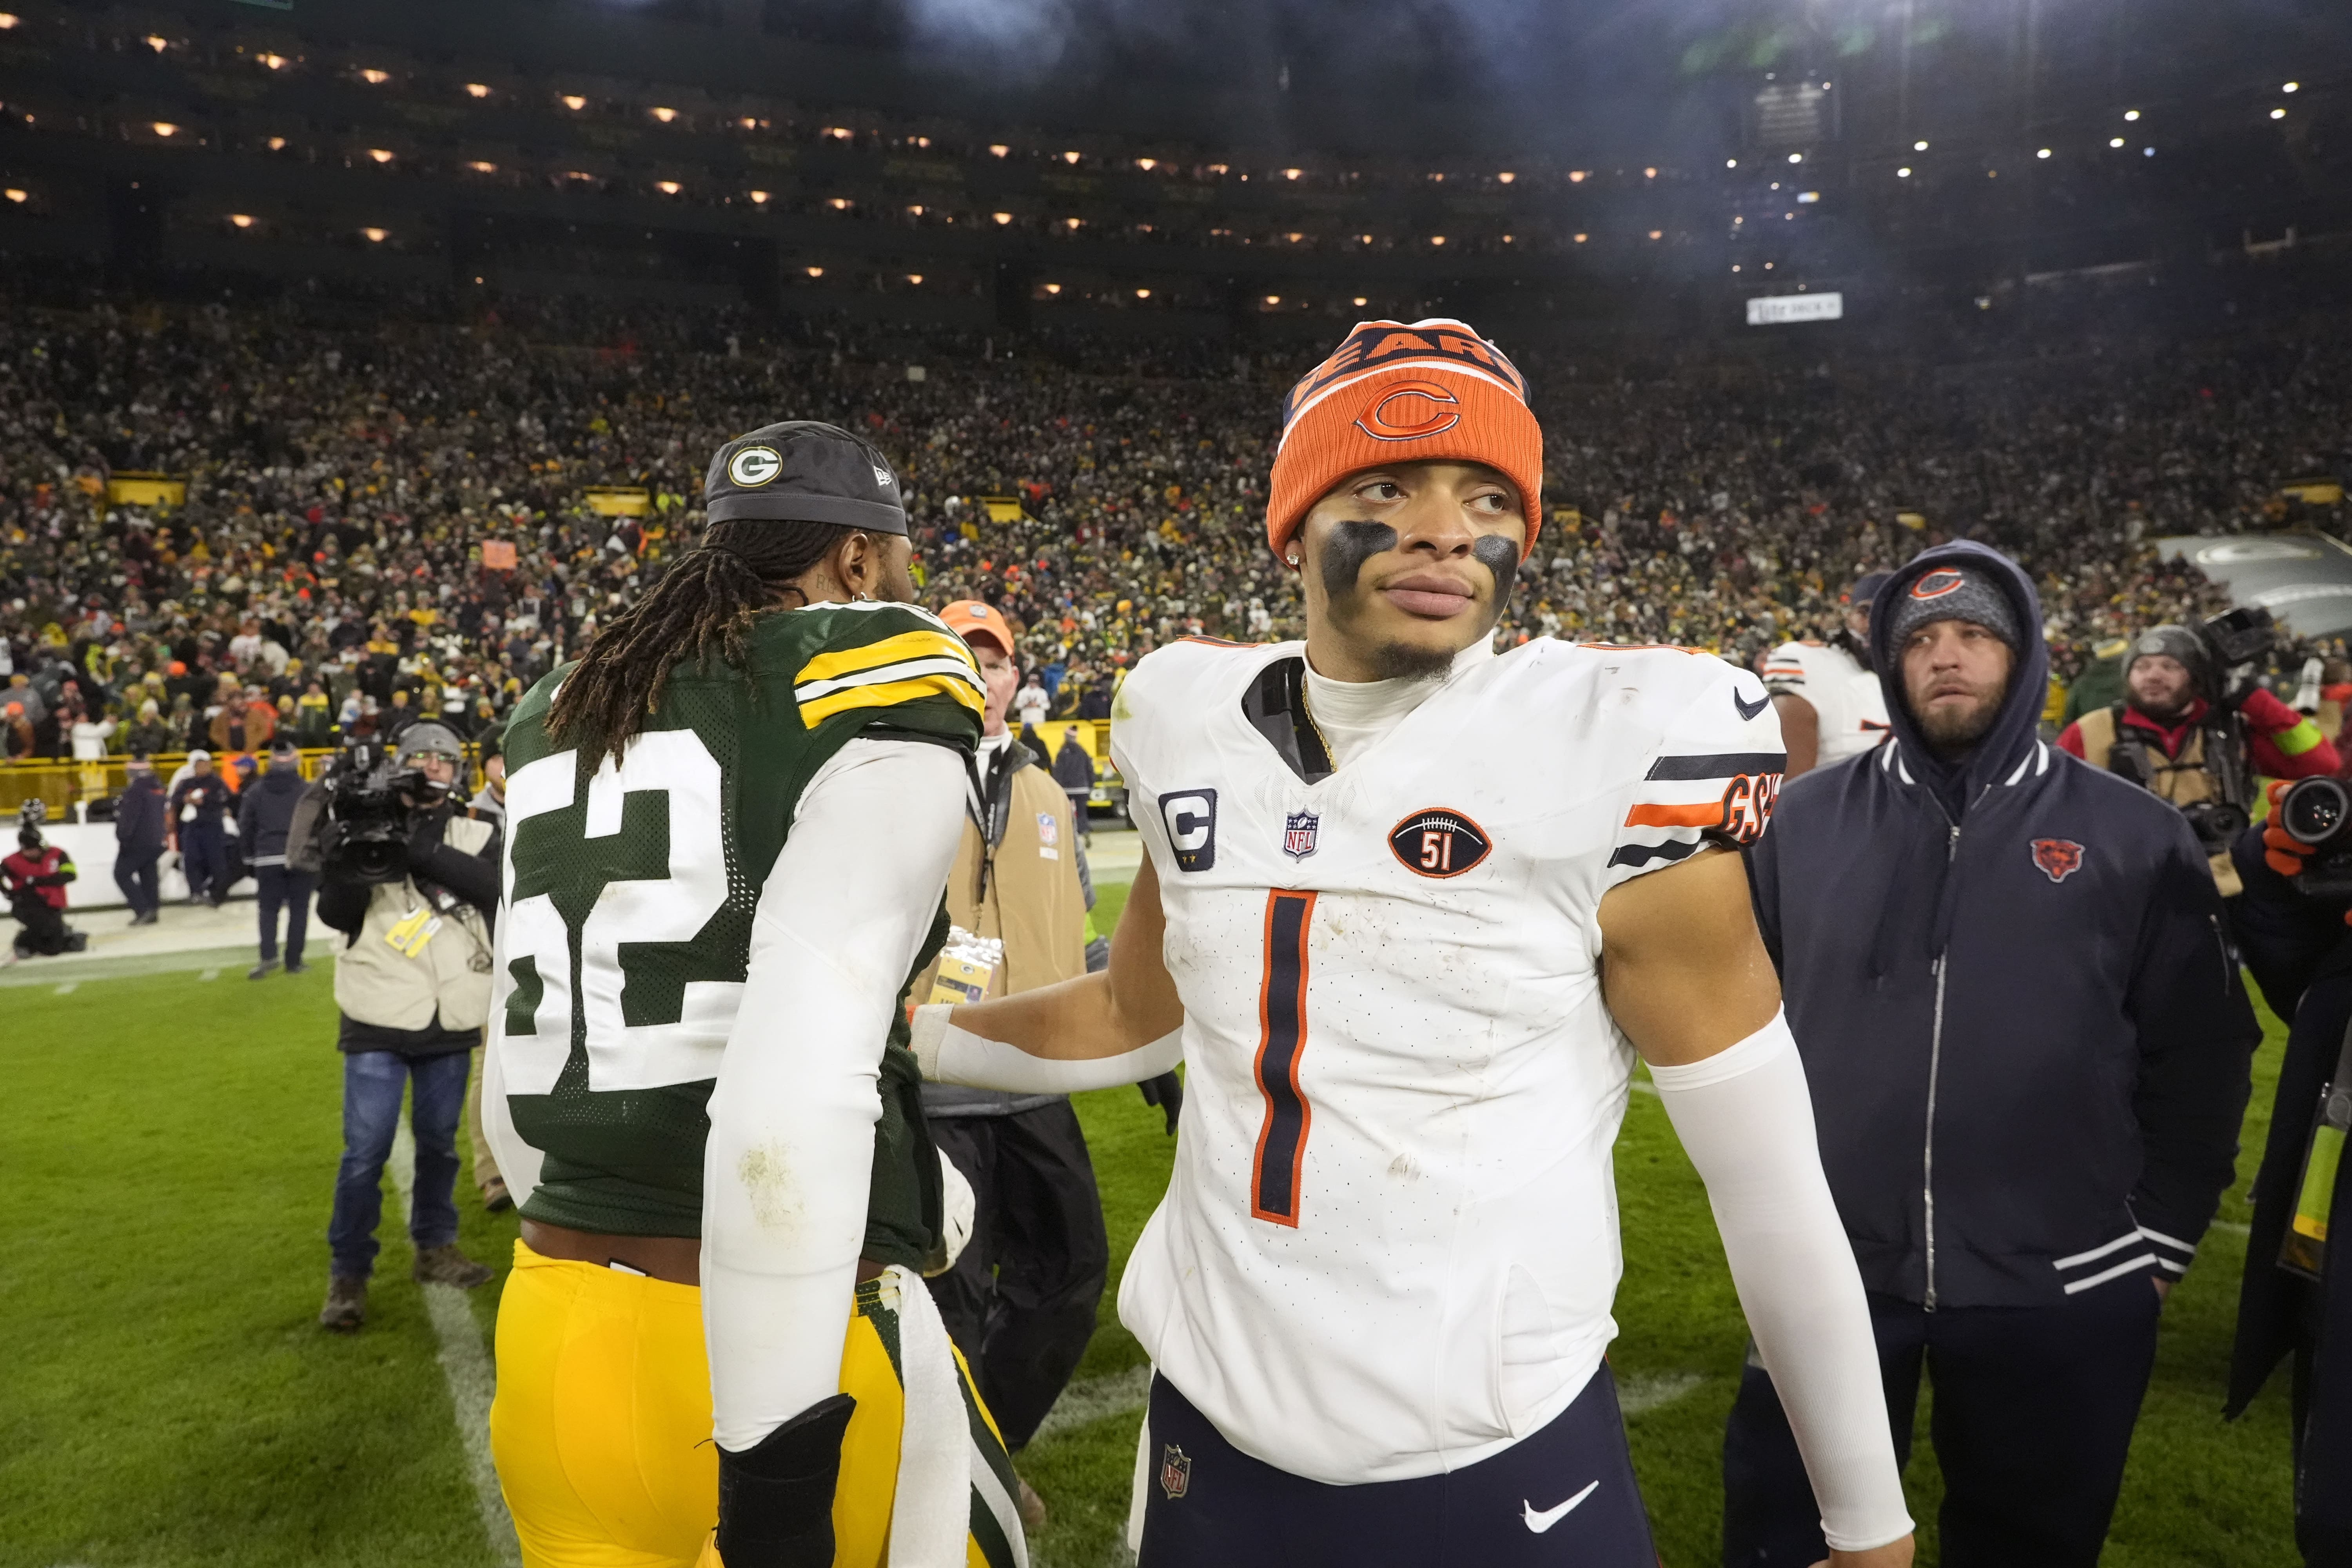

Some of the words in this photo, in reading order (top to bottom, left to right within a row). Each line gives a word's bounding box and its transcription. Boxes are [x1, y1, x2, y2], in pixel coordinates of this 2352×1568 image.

[1353, 380, 1460, 441] C
[731, 450, 779, 484] G
[1909, 567, 1965, 601] C
[1164, 795, 1211, 851] C
[1286, 831, 1312, 853] NFL
[1420, 831, 1452, 871] 51
[497, 728, 746, 1095] 52
[1251, 887, 1318, 1229] 1
[1165, 1464, 1182, 1491] NFL
